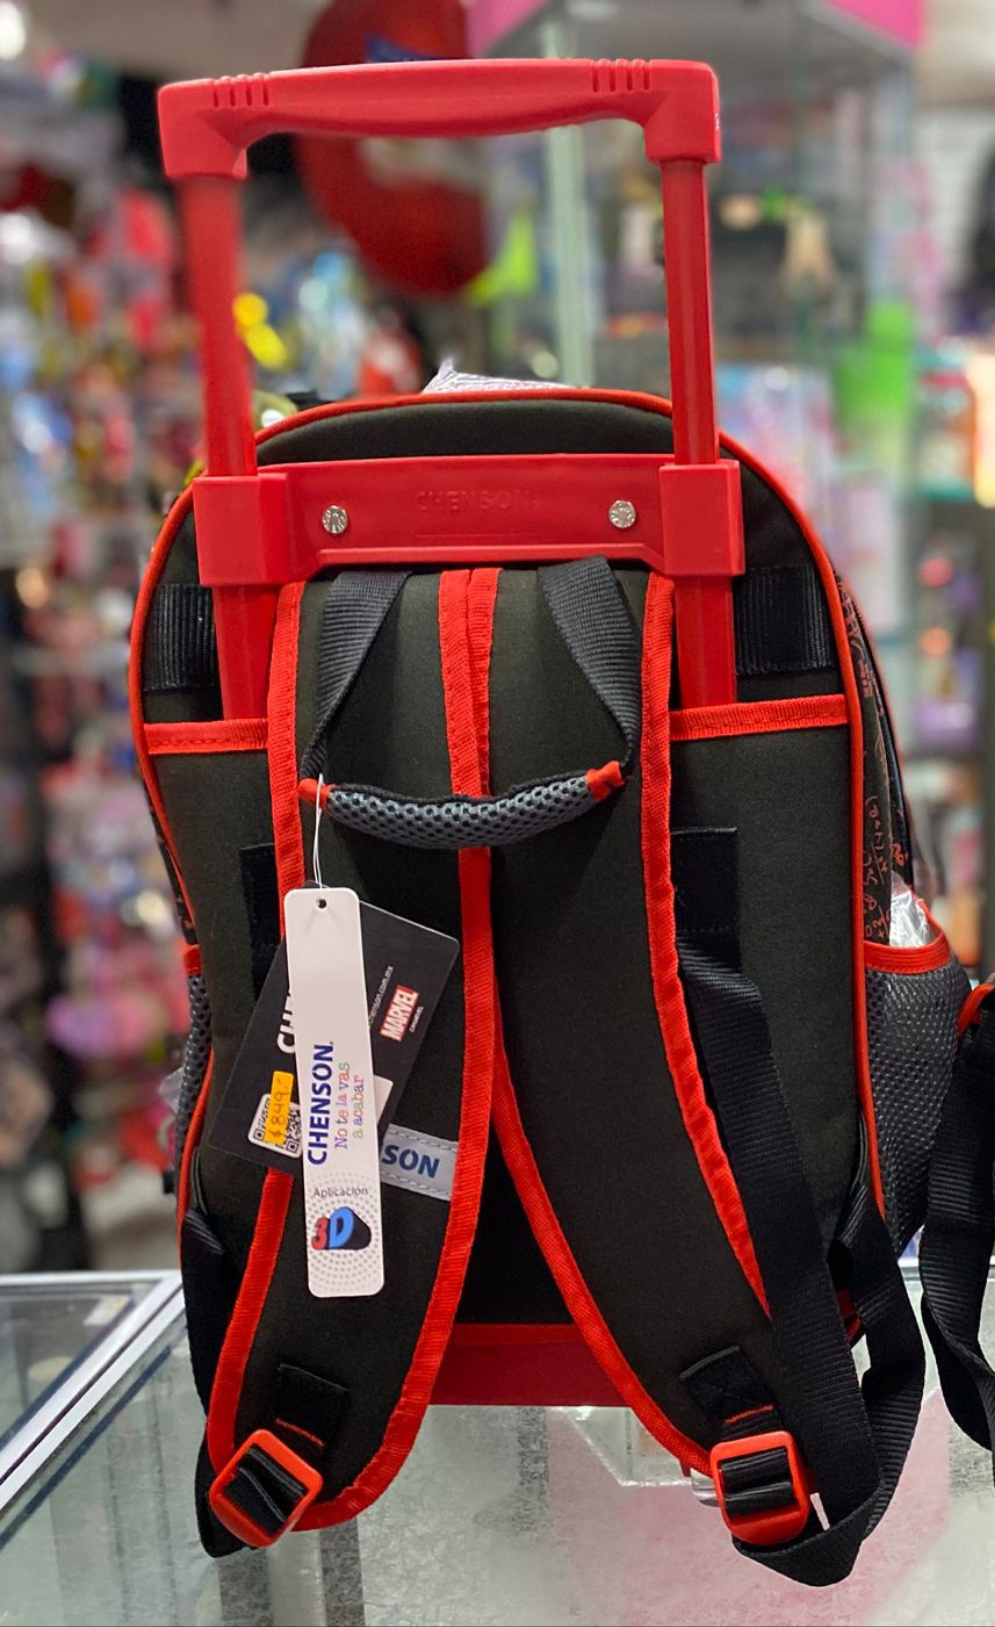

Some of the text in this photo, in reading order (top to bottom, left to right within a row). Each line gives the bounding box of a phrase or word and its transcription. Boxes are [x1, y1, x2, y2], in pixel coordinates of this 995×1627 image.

[379, 985, 419, 1041] MARVEL
[334, 1062, 350, 1149] No te la vas
[351, 1075, 364, 1139] a acabar
[311, 1206, 354, 1251] 3D
